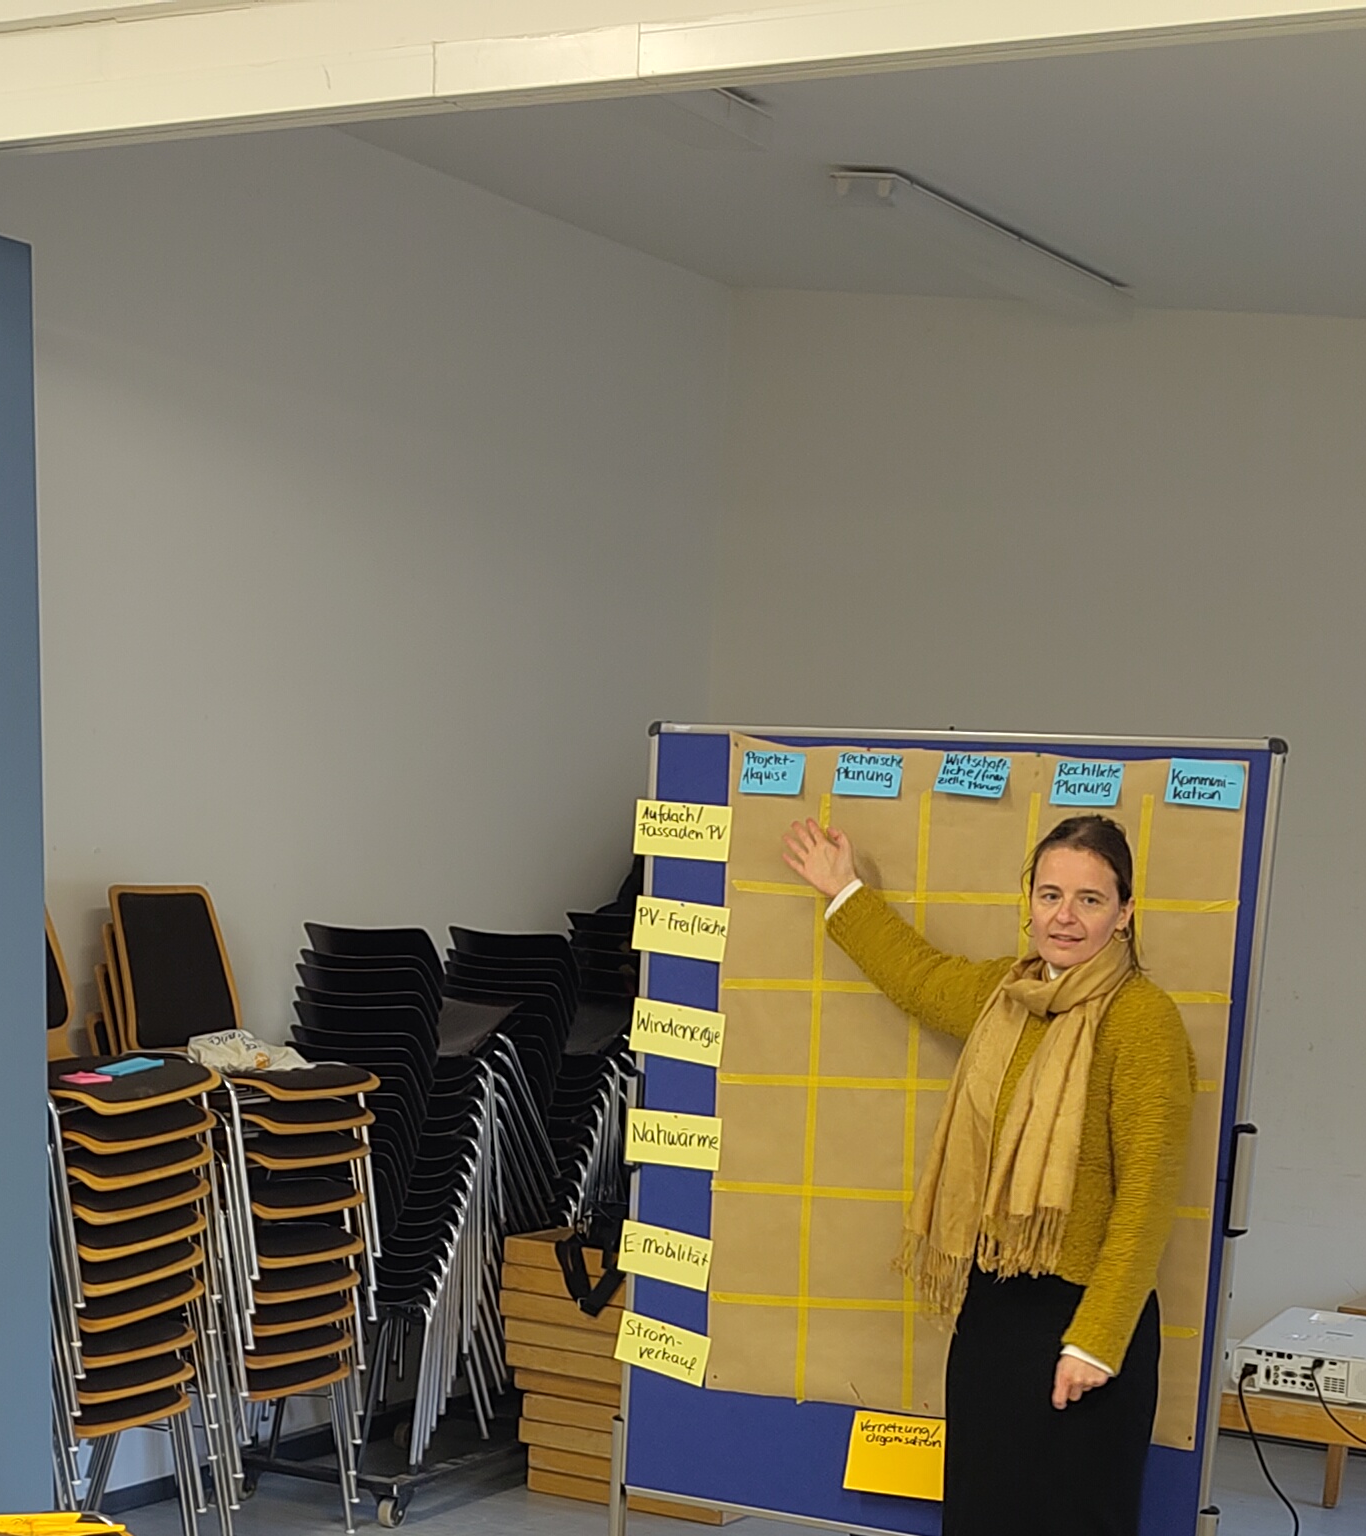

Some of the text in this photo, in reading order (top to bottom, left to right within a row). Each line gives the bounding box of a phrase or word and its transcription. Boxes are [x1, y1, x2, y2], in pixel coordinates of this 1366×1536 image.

[745, 751, 796, 768] Projekt-
[839, 752, 904, 769] Technische
[742, 767, 788, 785] Akquise
[836, 766, 893, 788] Planung
[1057, 762, 1122, 778] Rechtliche
[1171, 768, 1237, 788] Kommuni-
[1054, 779, 1112, 797] Planung
[1172, 786, 1222, 801] kation
[641, 804, 704, 824] Aufdach/
[638, 822, 727, 840] Fassaden PV
[638, 907, 727, 938] PV-Freifläche
[636, 1010, 721, 1048] Windenergie
[632, 1121, 719, 1150] Nahwärme
[624, 1318, 683, 1347] Strom-
[638, 1346, 698, 1375] verkauf
[860, 1419, 941, 1440] Vernetzung/
[865, 1433, 942, 1448] Organisation
